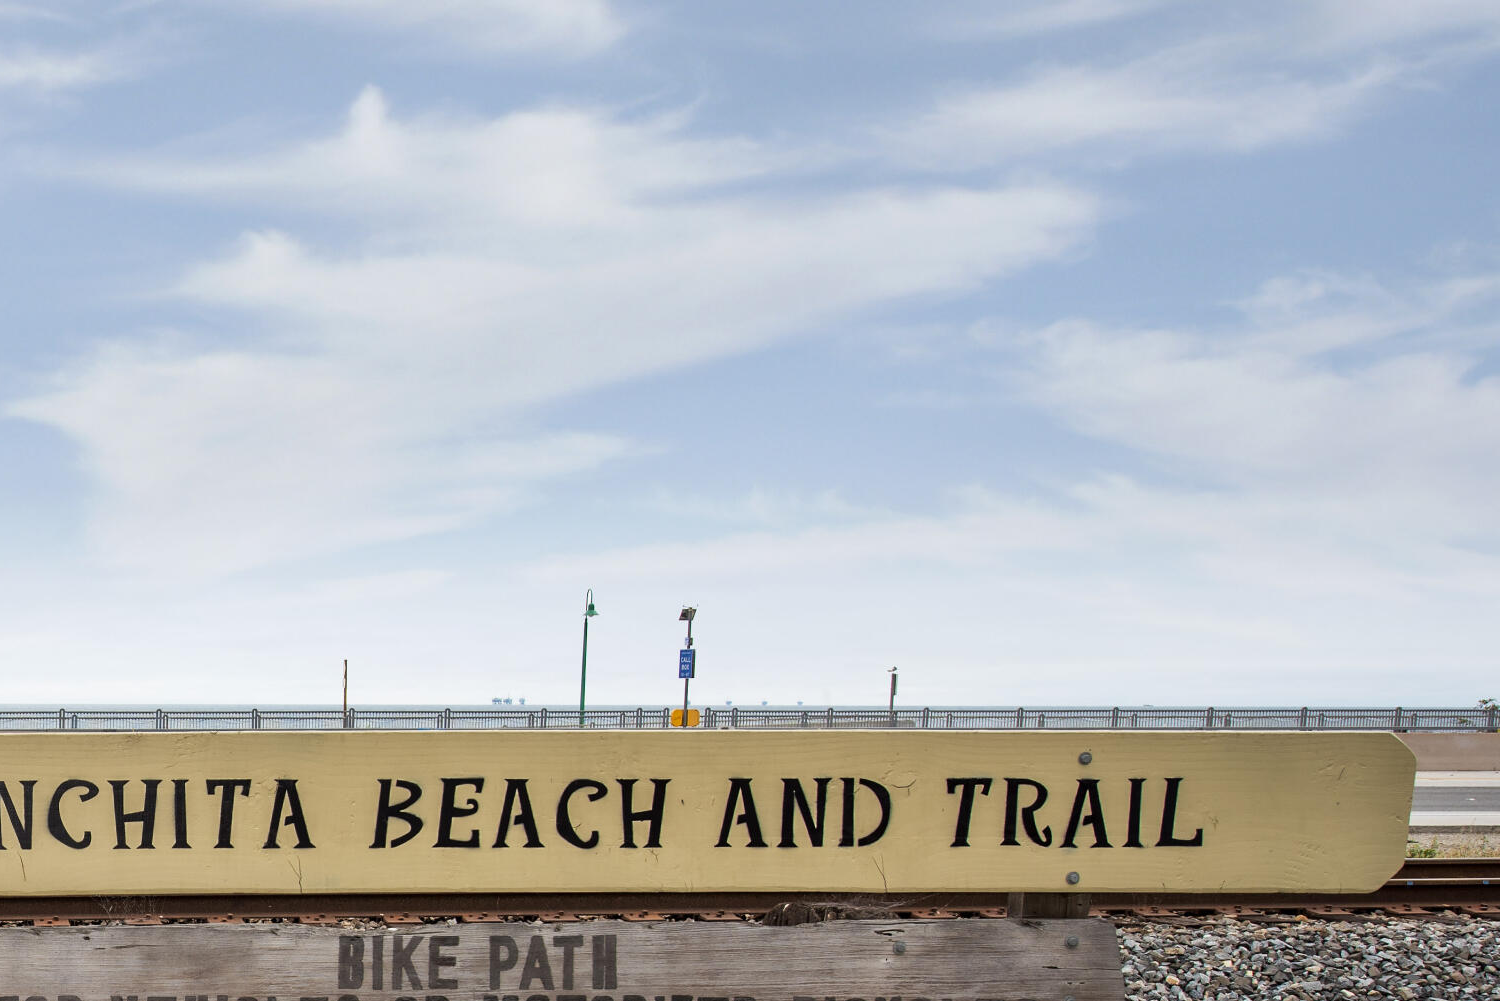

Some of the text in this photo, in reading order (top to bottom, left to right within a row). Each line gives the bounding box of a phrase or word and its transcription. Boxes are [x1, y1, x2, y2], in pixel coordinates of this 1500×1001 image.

[369, 778, 671, 849] BEACH
[714, 778, 891, 848] AND
[947, 777, 1203, 848] TRAIL
[338, 935, 617, 990] BIKE PATH
